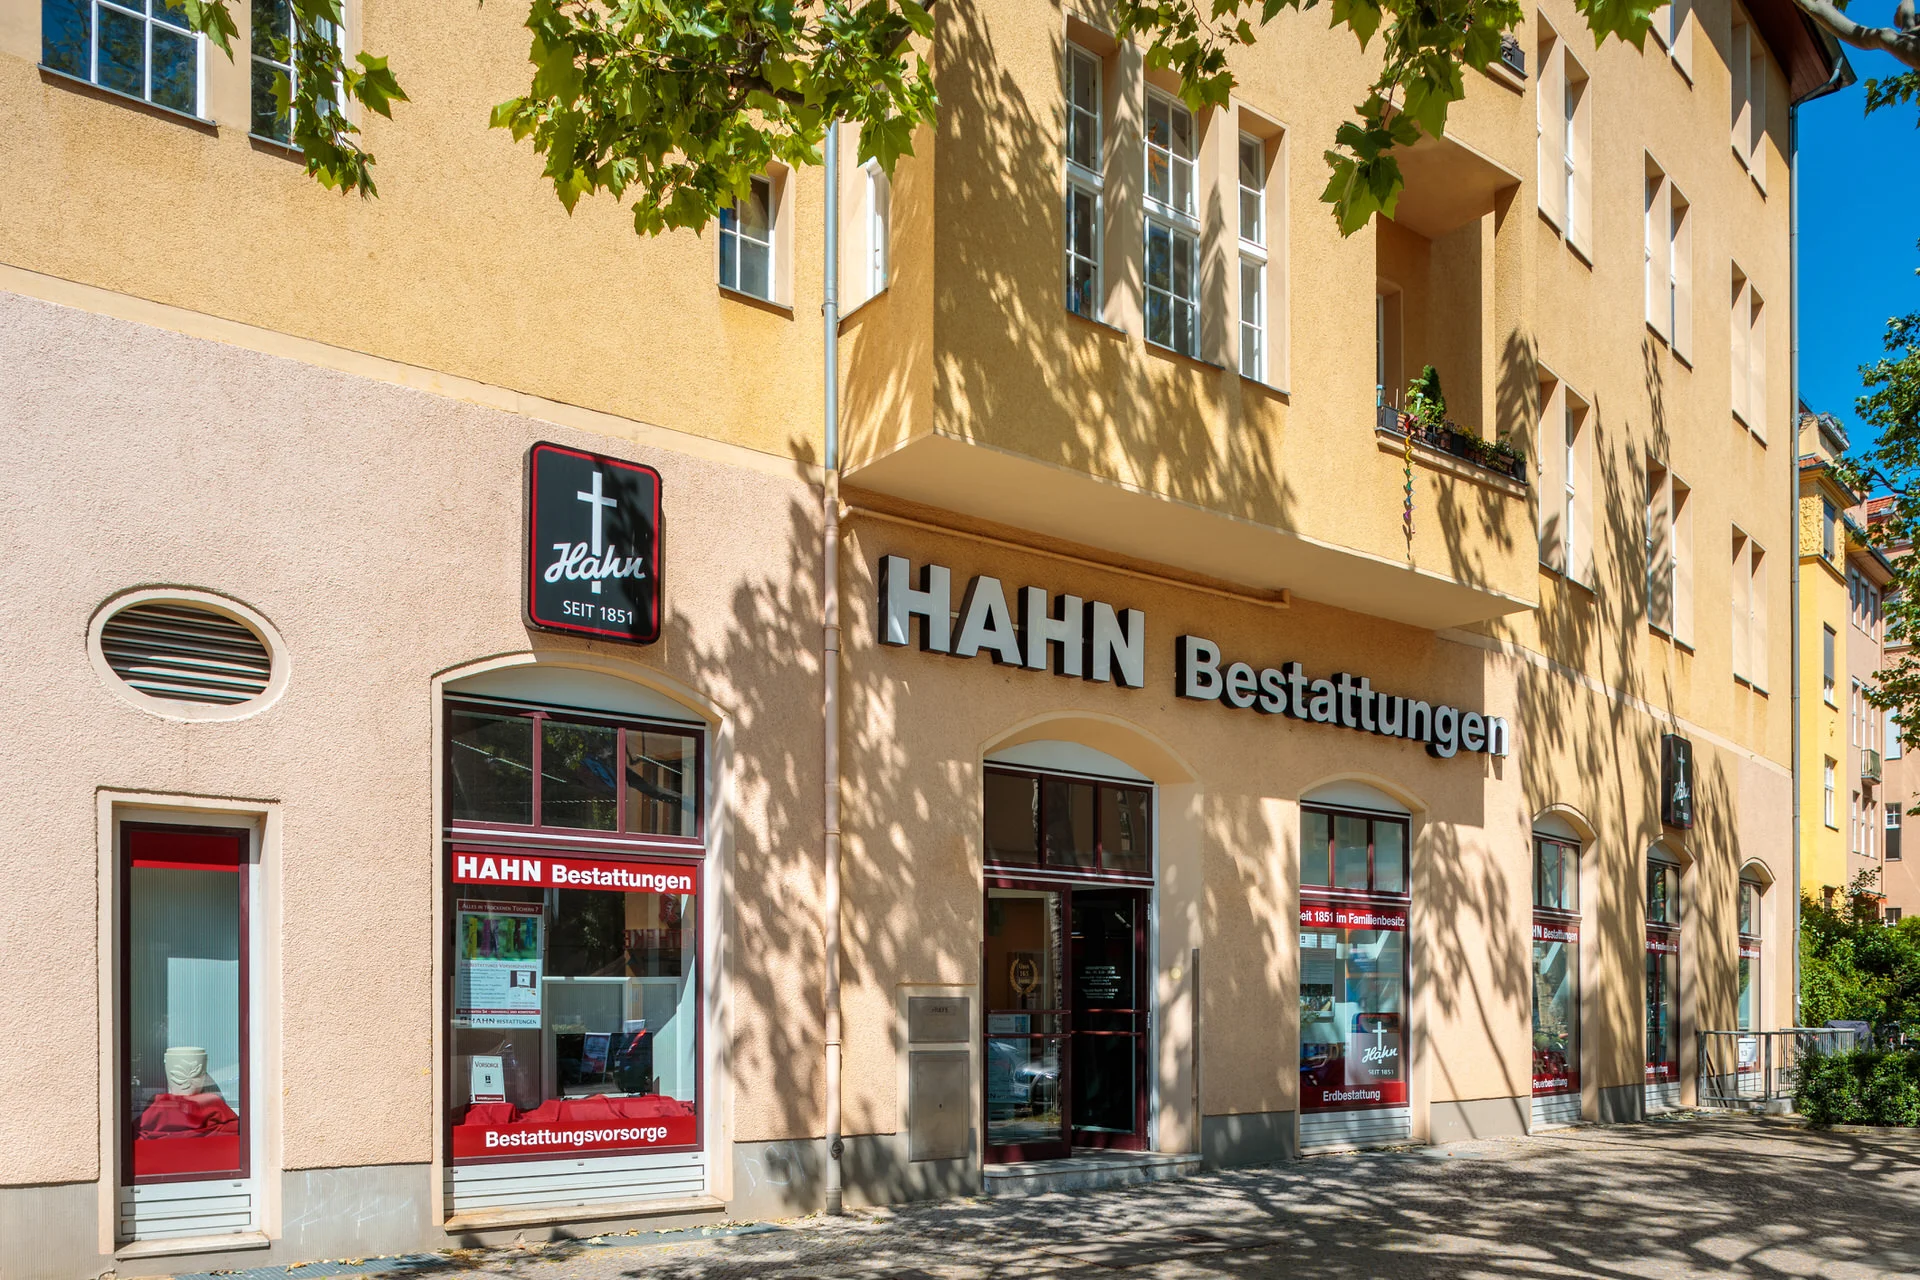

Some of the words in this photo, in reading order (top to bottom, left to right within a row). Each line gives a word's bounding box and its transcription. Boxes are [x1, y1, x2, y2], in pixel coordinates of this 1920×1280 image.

[544, 542, 646, 583] Hahn
[563, 600, 595, 618] SEIT
[600, 606, 634, 625] 1851
[879, 554, 1145, 689] HAHN
[1176, 634, 1509, 758] Bestattungen
[457, 856, 542, 882] HAHN
[551, 864, 692, 892] Bestattungen
[1314, 911, 1334, 923] 1851
[1336, 912, 1347, 924] im
[1348, 913, 1405, 927] Familienbesitz
[1533, 924, 1542, 938] HN
[1543, 927, 1577, 943] Bestattungen
[1361, 1045, 1398, 1064] Hahn
[1323, 1089, 1381, 1101] Erdbestattung
[485, 1126, 668, 1148] Bestattungsvorsorge
